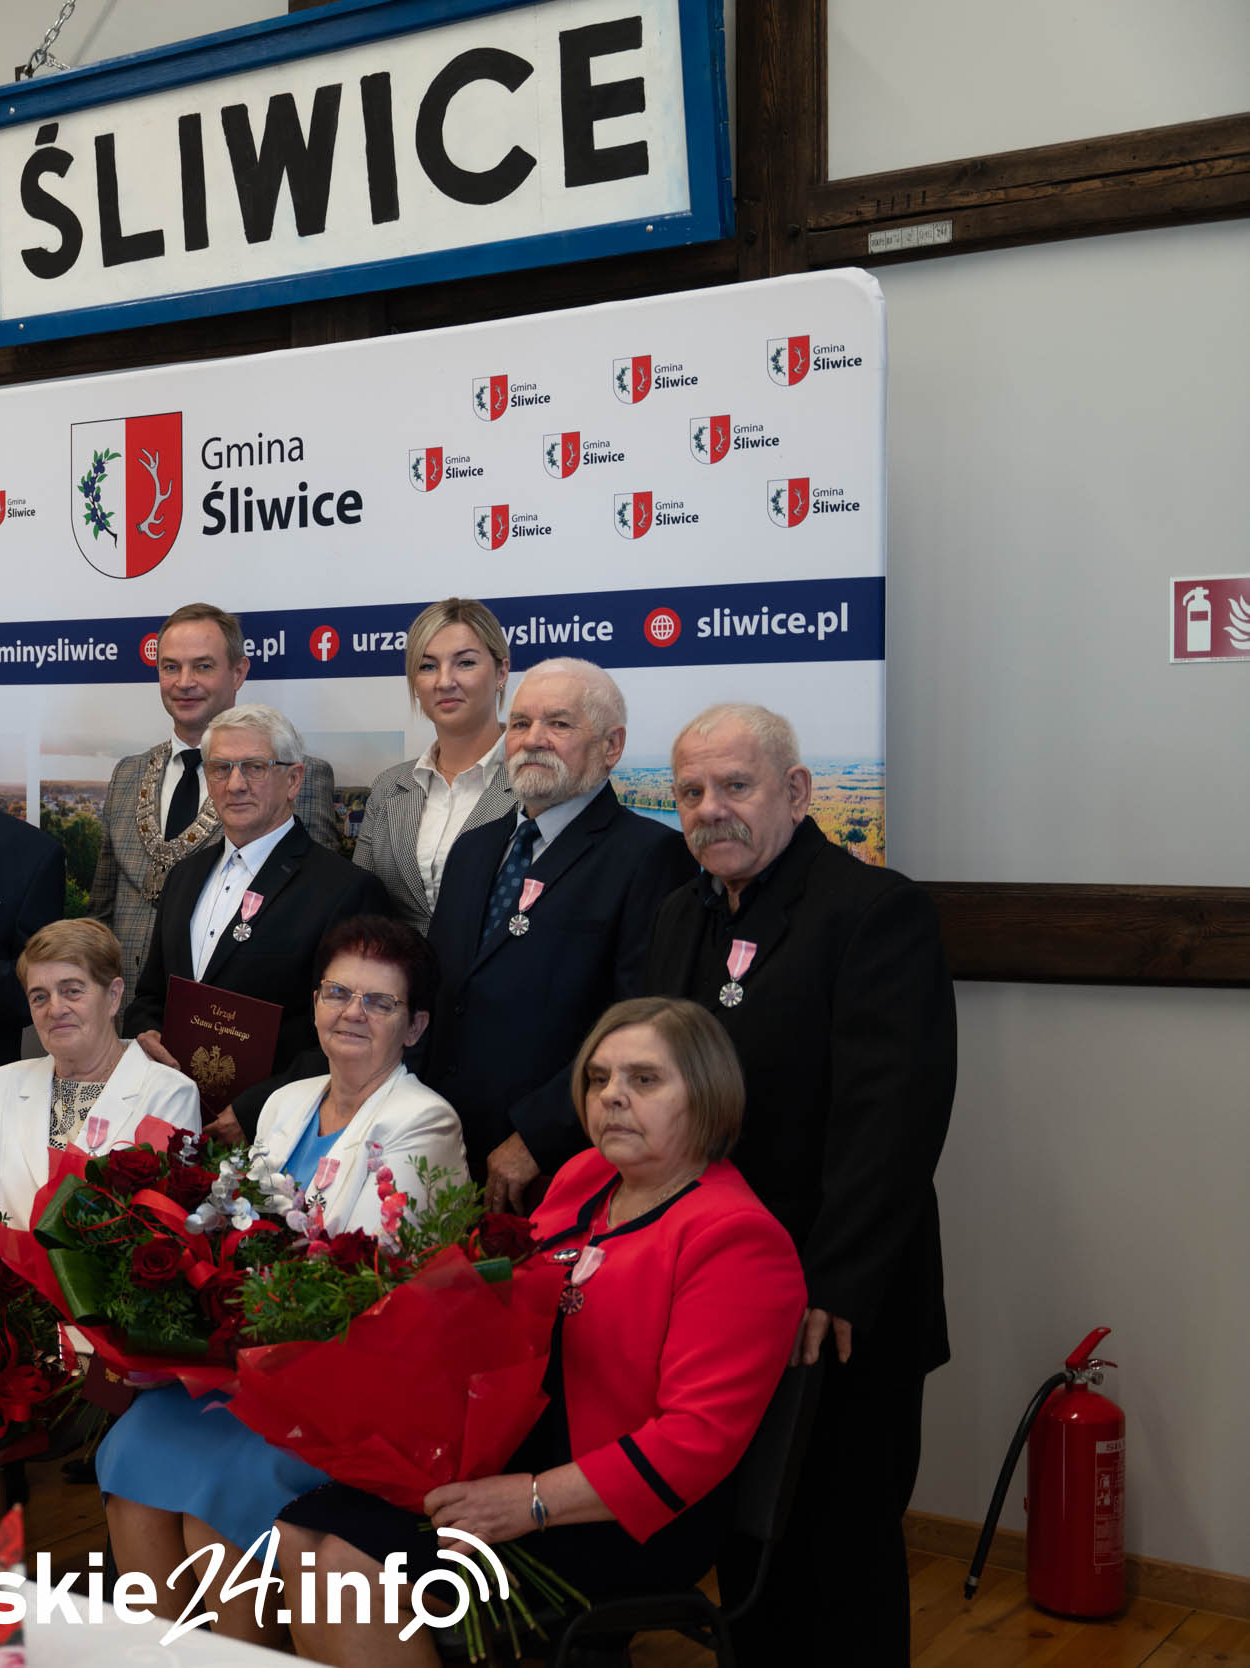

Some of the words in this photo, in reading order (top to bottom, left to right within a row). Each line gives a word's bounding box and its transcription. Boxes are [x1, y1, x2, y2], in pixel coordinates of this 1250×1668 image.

[20, 16, 649, 280] ŚLIWICE
[813, 343, 845, 356] Gmina
[654, 362, 683, 374] Gmina
[813, 354, 863, 371] Śliwice
[510, 381, 537, 393] Gmina
[654, 373, 699, 389] Śliwice
[510, 392, 551, 407] Śliwice
[733, 423, 764, 435] Gmina
[583, 439, 611, 450] Gmina
[733, 434, 780, 449] Śliwice
[201, 432, 304, 470] Gmina
[583, 449, 625, 464] Śliwice
[445, 454, 470, 465] Gmina
[445, 465, 484, 479] Śliwice
[812, 486, 844, 498] Gmina
[7, 506, 36, 518] Śliwice
[202, 480, 364, 536] Śliwice
[655, 499, 684, 511] Gmina
[812, 498, 860, 514] Śliwice
[511, 512, 538, 522] Gmina
[655, 510, 699, 526] Śliwice
[511, 522, 552, 537] Śliwice
[697, 602, 848, 640] sliwice.pl
